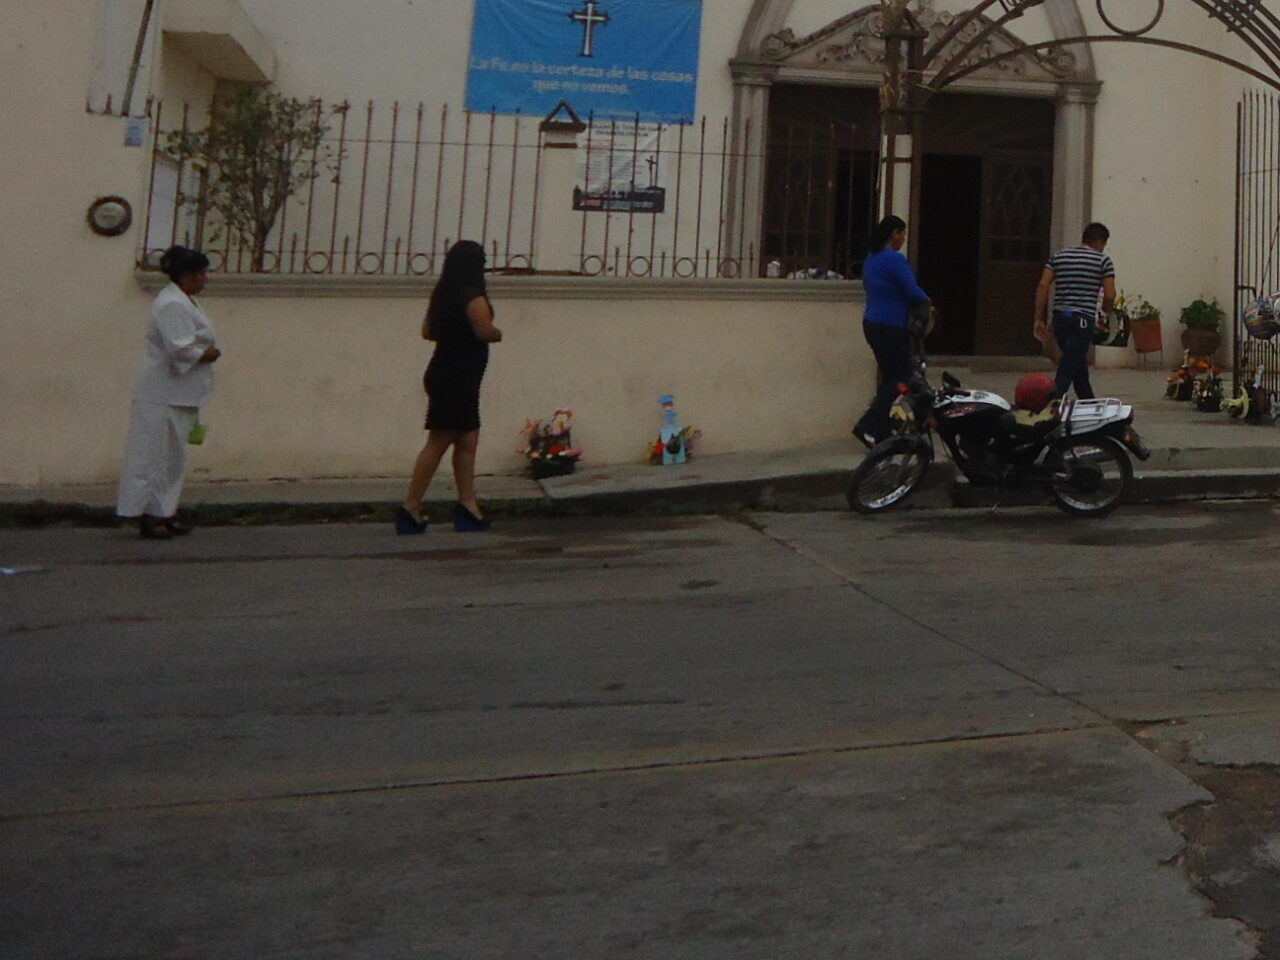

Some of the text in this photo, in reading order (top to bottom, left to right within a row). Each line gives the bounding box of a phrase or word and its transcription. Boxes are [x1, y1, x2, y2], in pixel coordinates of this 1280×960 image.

[532, 60, 545, 74] la
[606, 65, 625, 79] de
[627, 66, 649, 81] las
